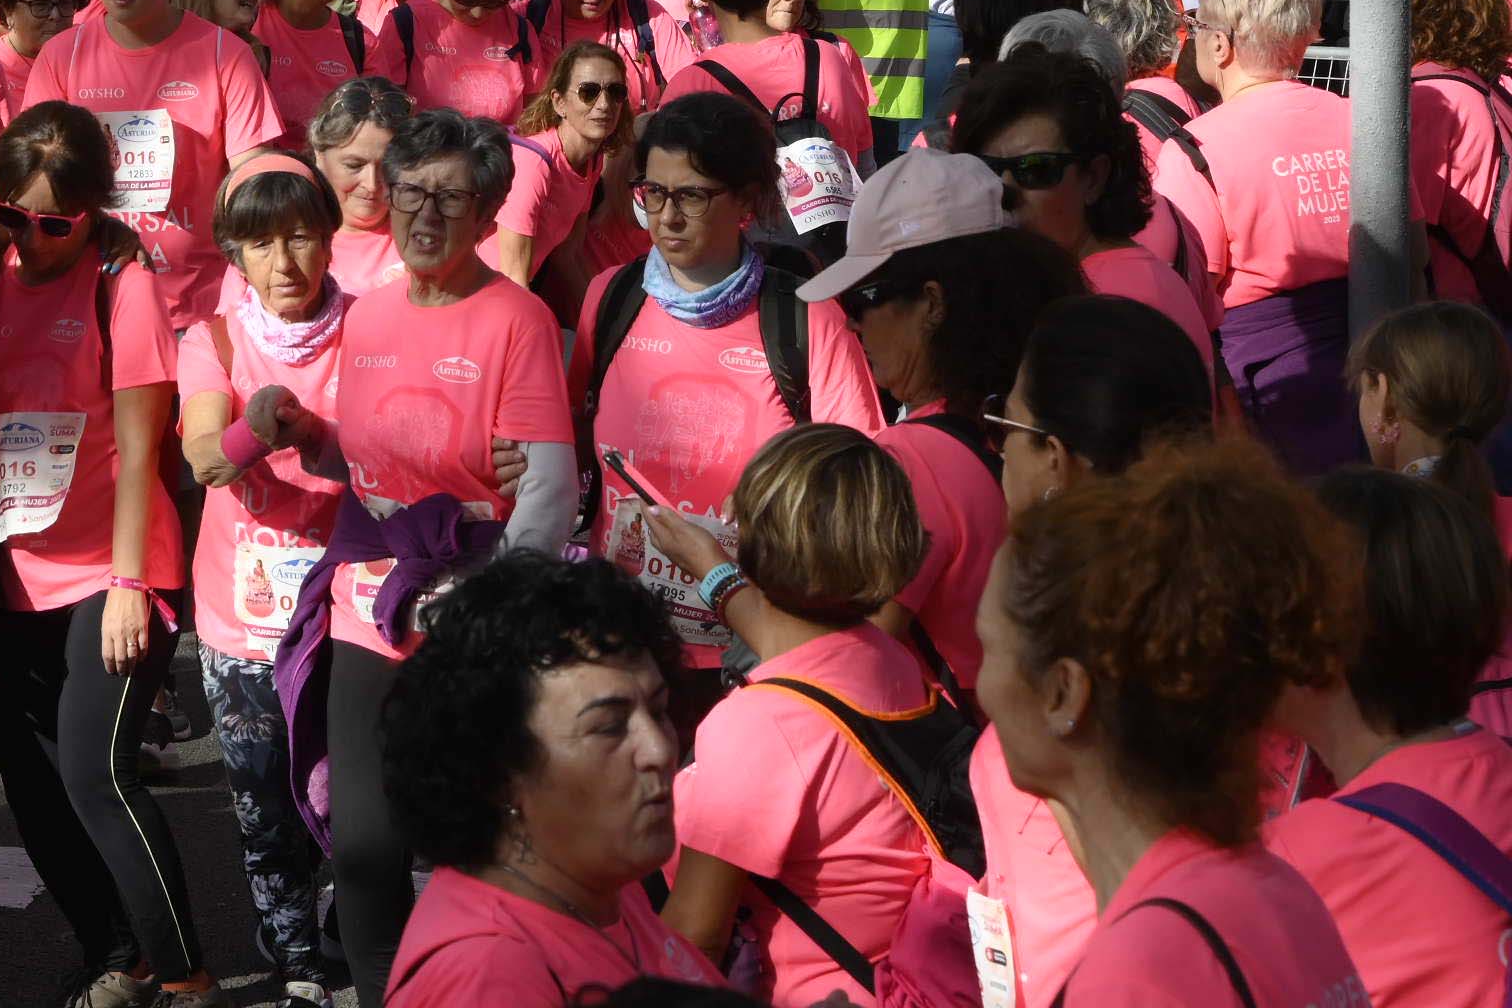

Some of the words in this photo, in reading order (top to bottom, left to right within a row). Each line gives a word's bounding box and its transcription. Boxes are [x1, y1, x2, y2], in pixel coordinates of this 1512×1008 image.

[78, 87, 125, 99] OYSHO
[124, 150, 156, 165] 016
[1272, 149, 1350, 177] CARRER
[813, 171, 843, 184] 016
[1296, 172, 1322, 194] DE
[1326, 170, 1350, 191] LA
[801, 197, 830, 211] CARRERA
[354, 355, 397, 368] OYSHO
[674, 606, 703, 621] MUJER
